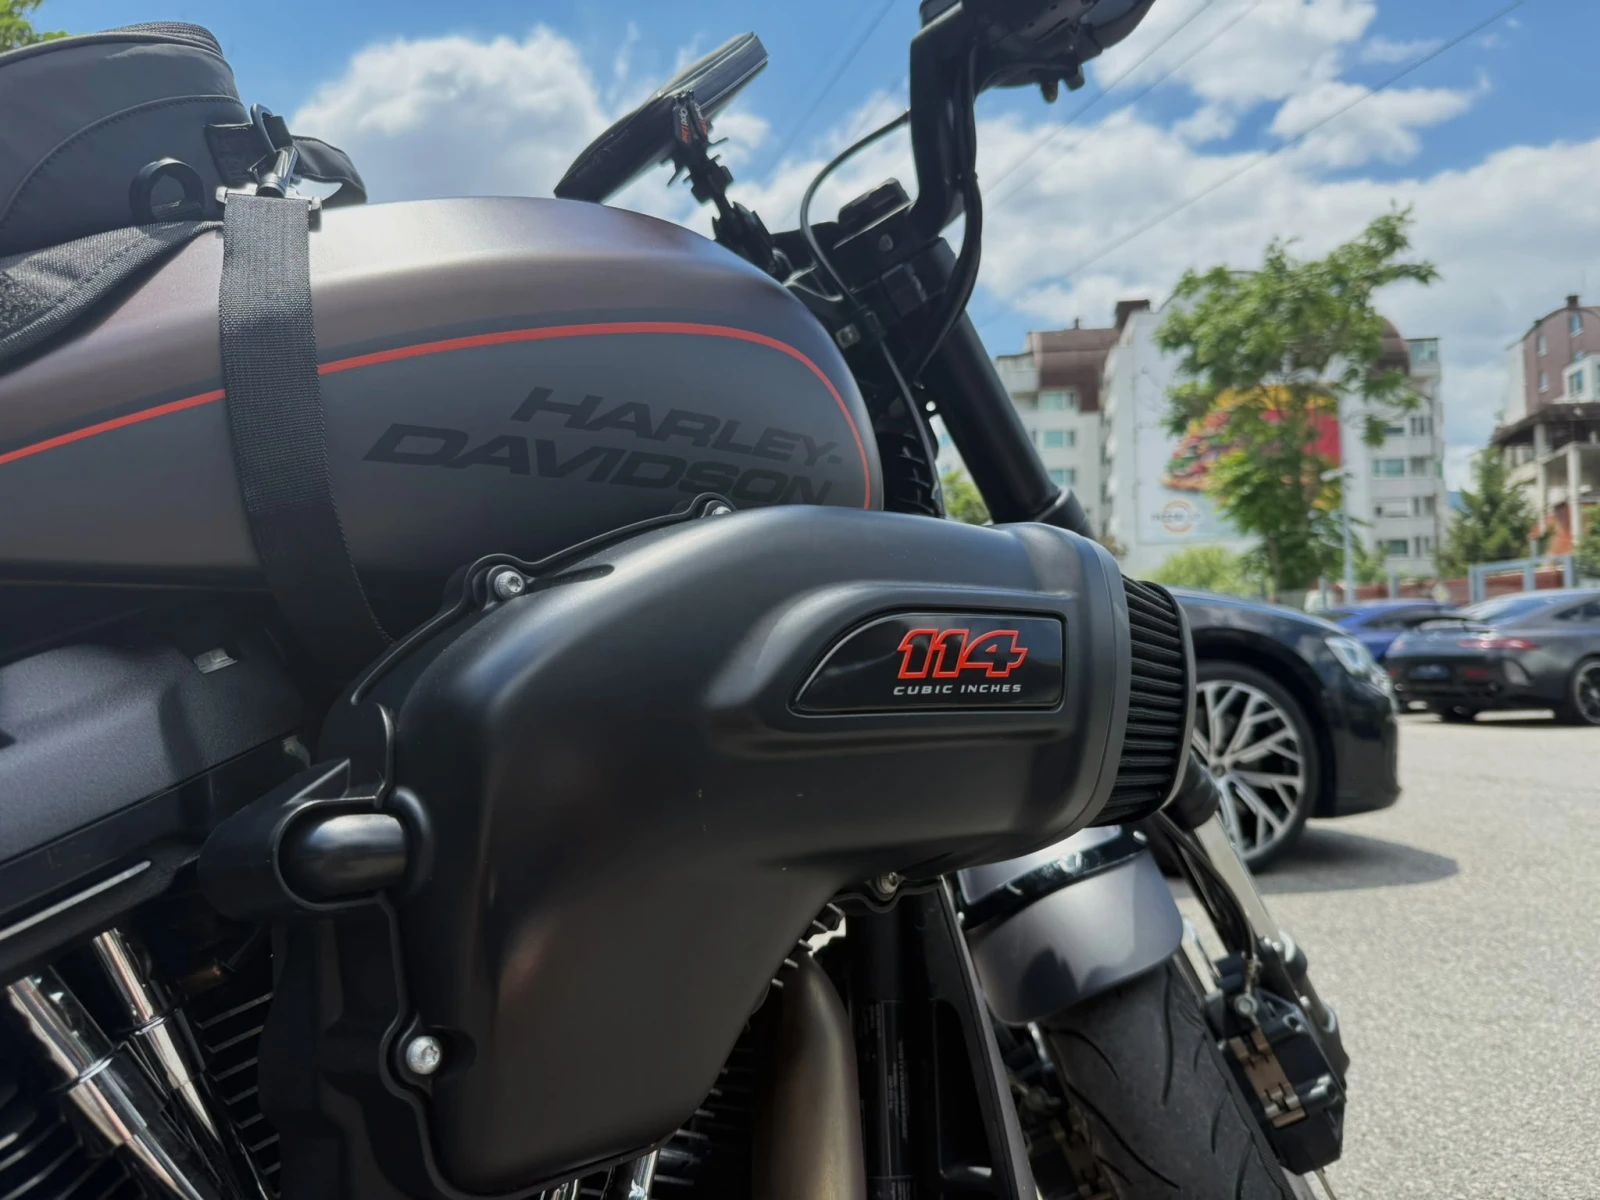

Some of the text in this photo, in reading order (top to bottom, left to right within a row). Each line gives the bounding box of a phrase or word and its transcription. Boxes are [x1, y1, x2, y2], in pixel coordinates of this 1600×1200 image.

[510, 386, 843, 466] HARLEY-
[362, 423, 833, 505] DAVIDSON
[897, 629, 1028, 678] 114
[893, 684, 1022, 695] CUBIC INCHES
